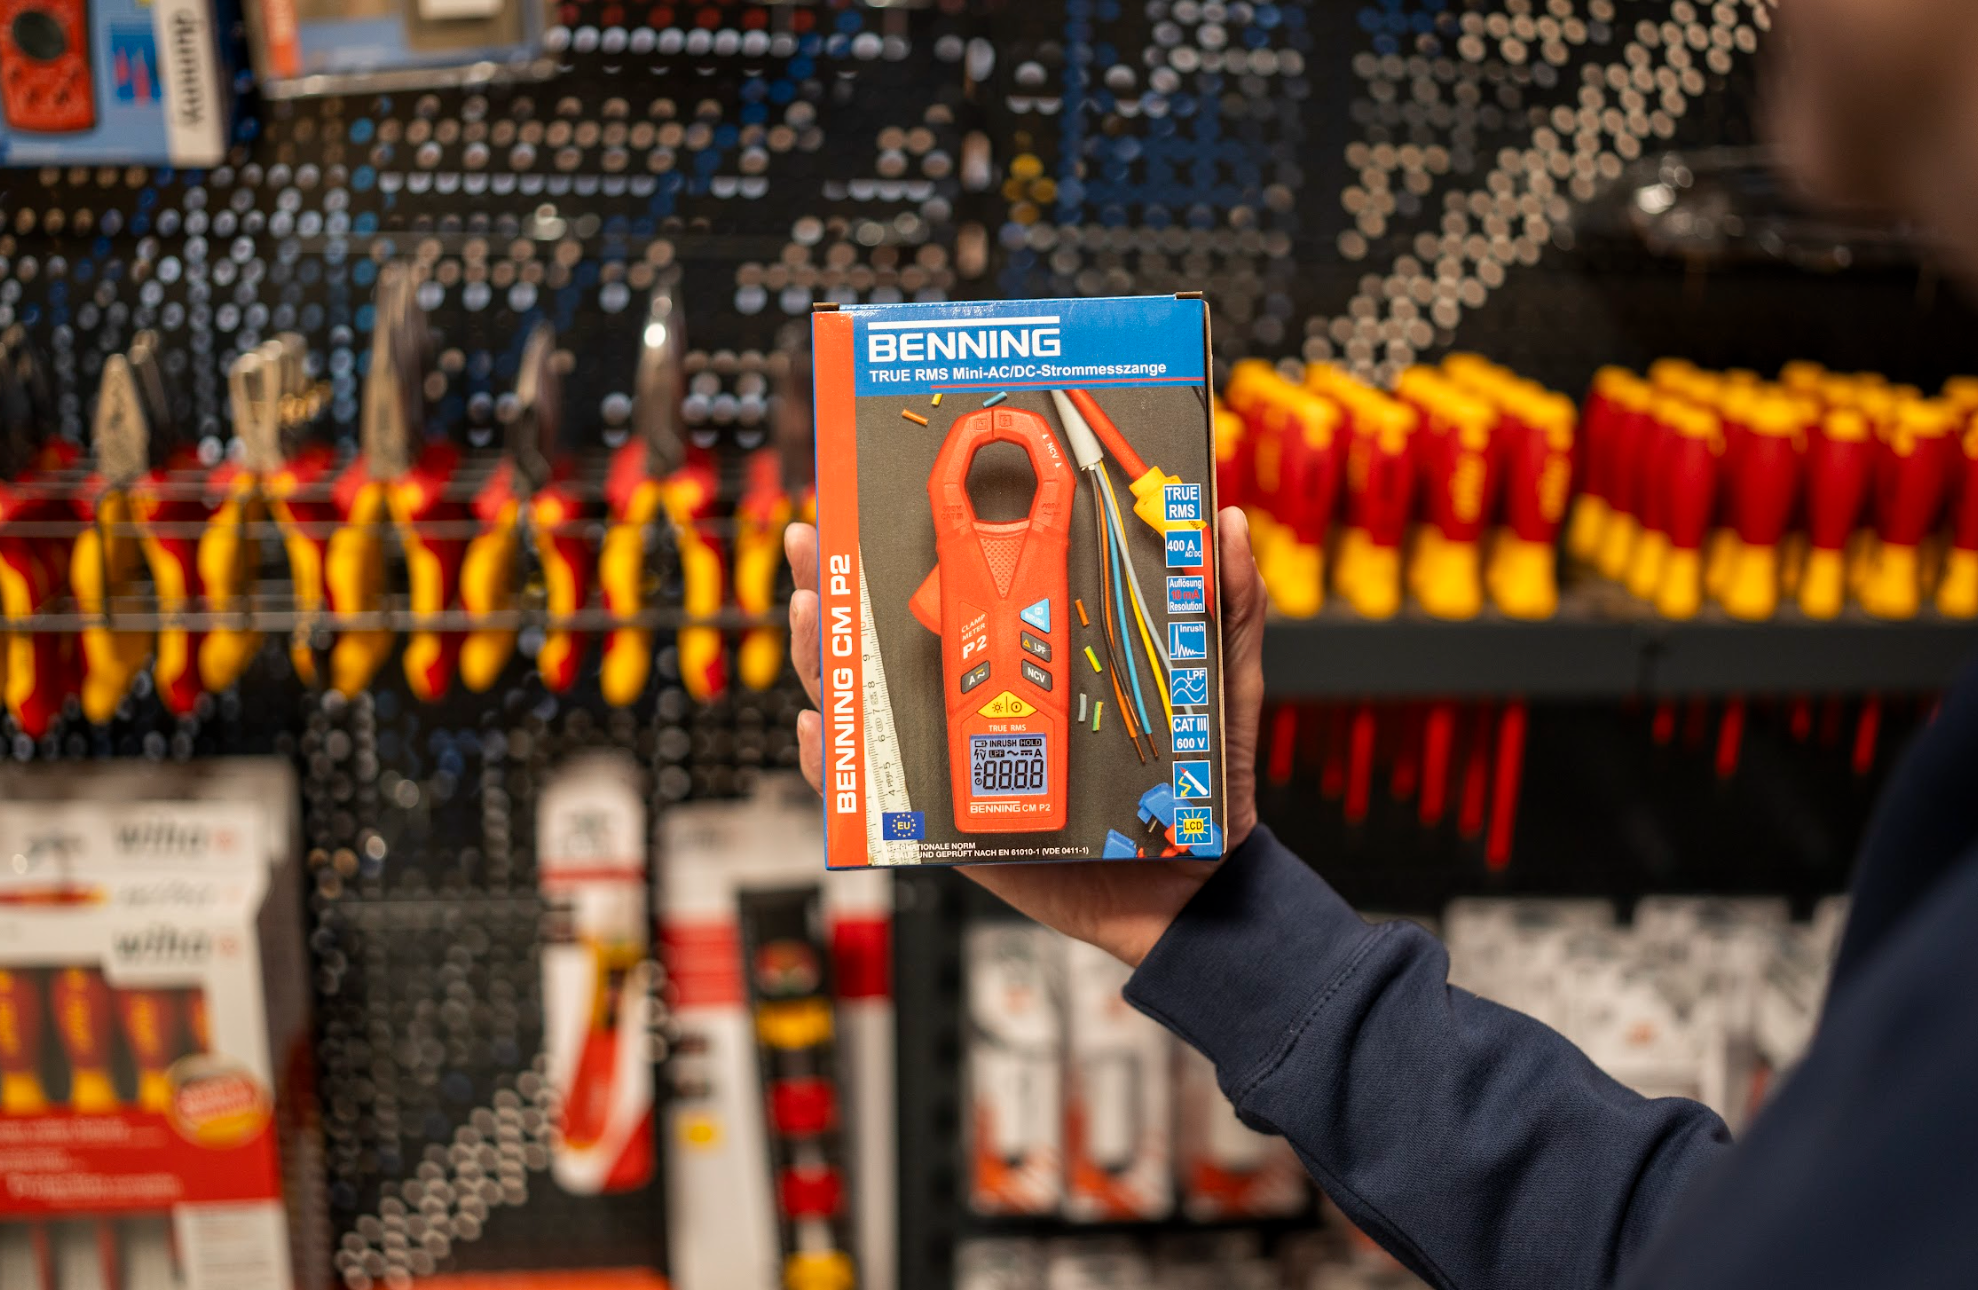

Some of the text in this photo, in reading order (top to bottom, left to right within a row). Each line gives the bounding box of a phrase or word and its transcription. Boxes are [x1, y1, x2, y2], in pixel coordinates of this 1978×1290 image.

[868, 328, 1061, 363] BENNING
[869, 363, 1167, 383] TRUE RMS Mini-AC/DC-Strommesszange
[1046, 442, 1060, 459] NCV
[1165, 486, 1199, 501] TRUE
[1169, 504, 1195, 518] RMS
[1167, 539, 1196, 552] 400 A
[1169, 578, 1202, 589] Auflösung
[1171, 589, 1200, 600] 10 mA
[1169, 601, 1203, 611] Resolution
[961, 614, 986, 633] CLAMP
[1179, 624, 1204, 632] Inrush
[962, 623, 986, 642] METER
[963, 635, 987, 660] P2
[1034, 643, 1046, 655] LPF
[863, 653, 871, 662] 9
[1027, 666, 1046, 683] NCV
[1186, 670, 1205, 680] LPF
[830, 554, 858, 814] BENNING CM P2
[867, 680, 876, 689] 8
[988, 724, 1008, 732] TRUE
[1173, 717, 1207, 732] CAT III
[989, 738, 1041, 747] INRUSH HOLD
[1176, 738, 1206, 749] 600 V
[989, 750, 1005, 758] LPF
[970, 803, 1051, 814] BENNING CM P2
[897, 821, 911, 830] EU
[1184, 821, 1203, 830] LCD
[951, 841, 976, 850] NORM
[917, 850, 935, 858] UND
[936, 848, 973, 858] GEPRÜFT
[974, 848, 997, 857] NACH
[998, 848, 1010, 856] EN
[1010, 847, 1040, 856] 61010-1
[1041, 847, 1060, 856] (VDE
[1061, 846, 1090, 855] 0411-1)
